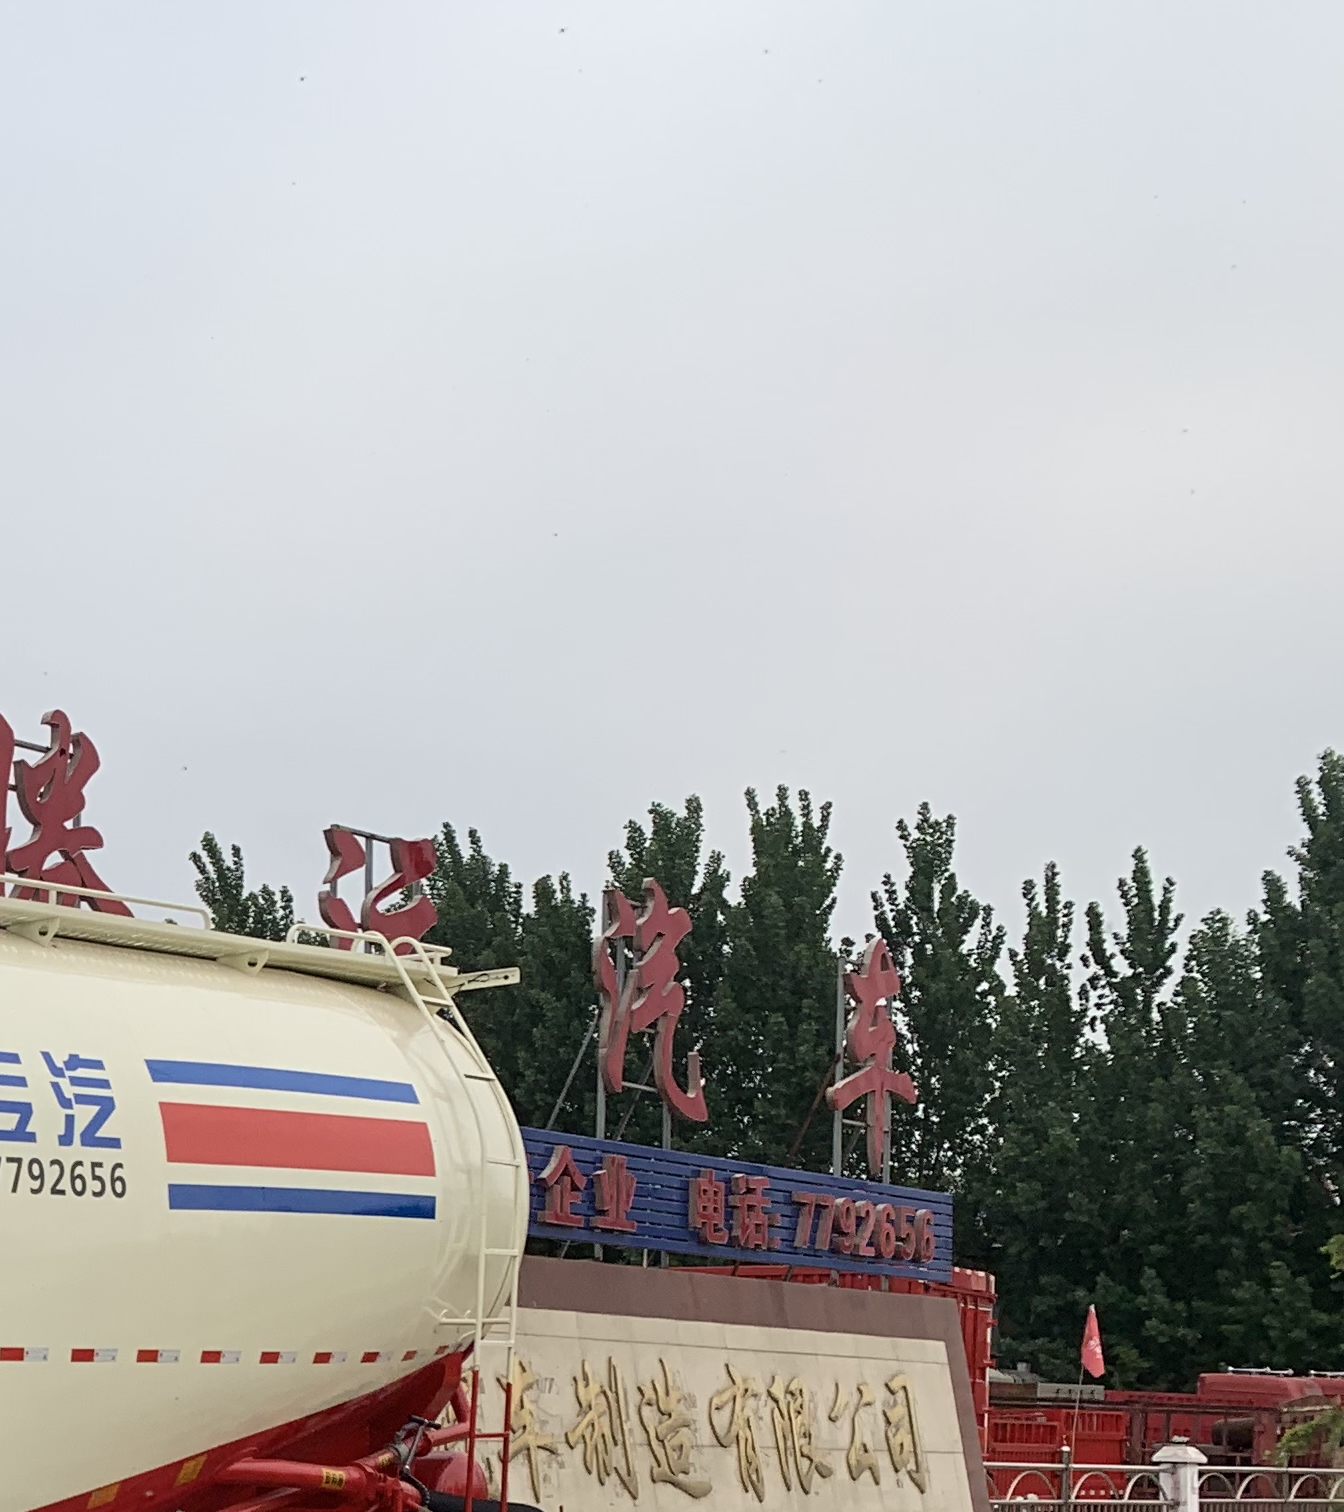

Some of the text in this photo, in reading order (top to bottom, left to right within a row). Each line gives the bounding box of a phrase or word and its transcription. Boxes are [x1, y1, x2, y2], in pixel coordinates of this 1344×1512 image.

[518, 1145, 637, 1233] 企业
[446, 1354, 928, 1504] 车制造有限公司
